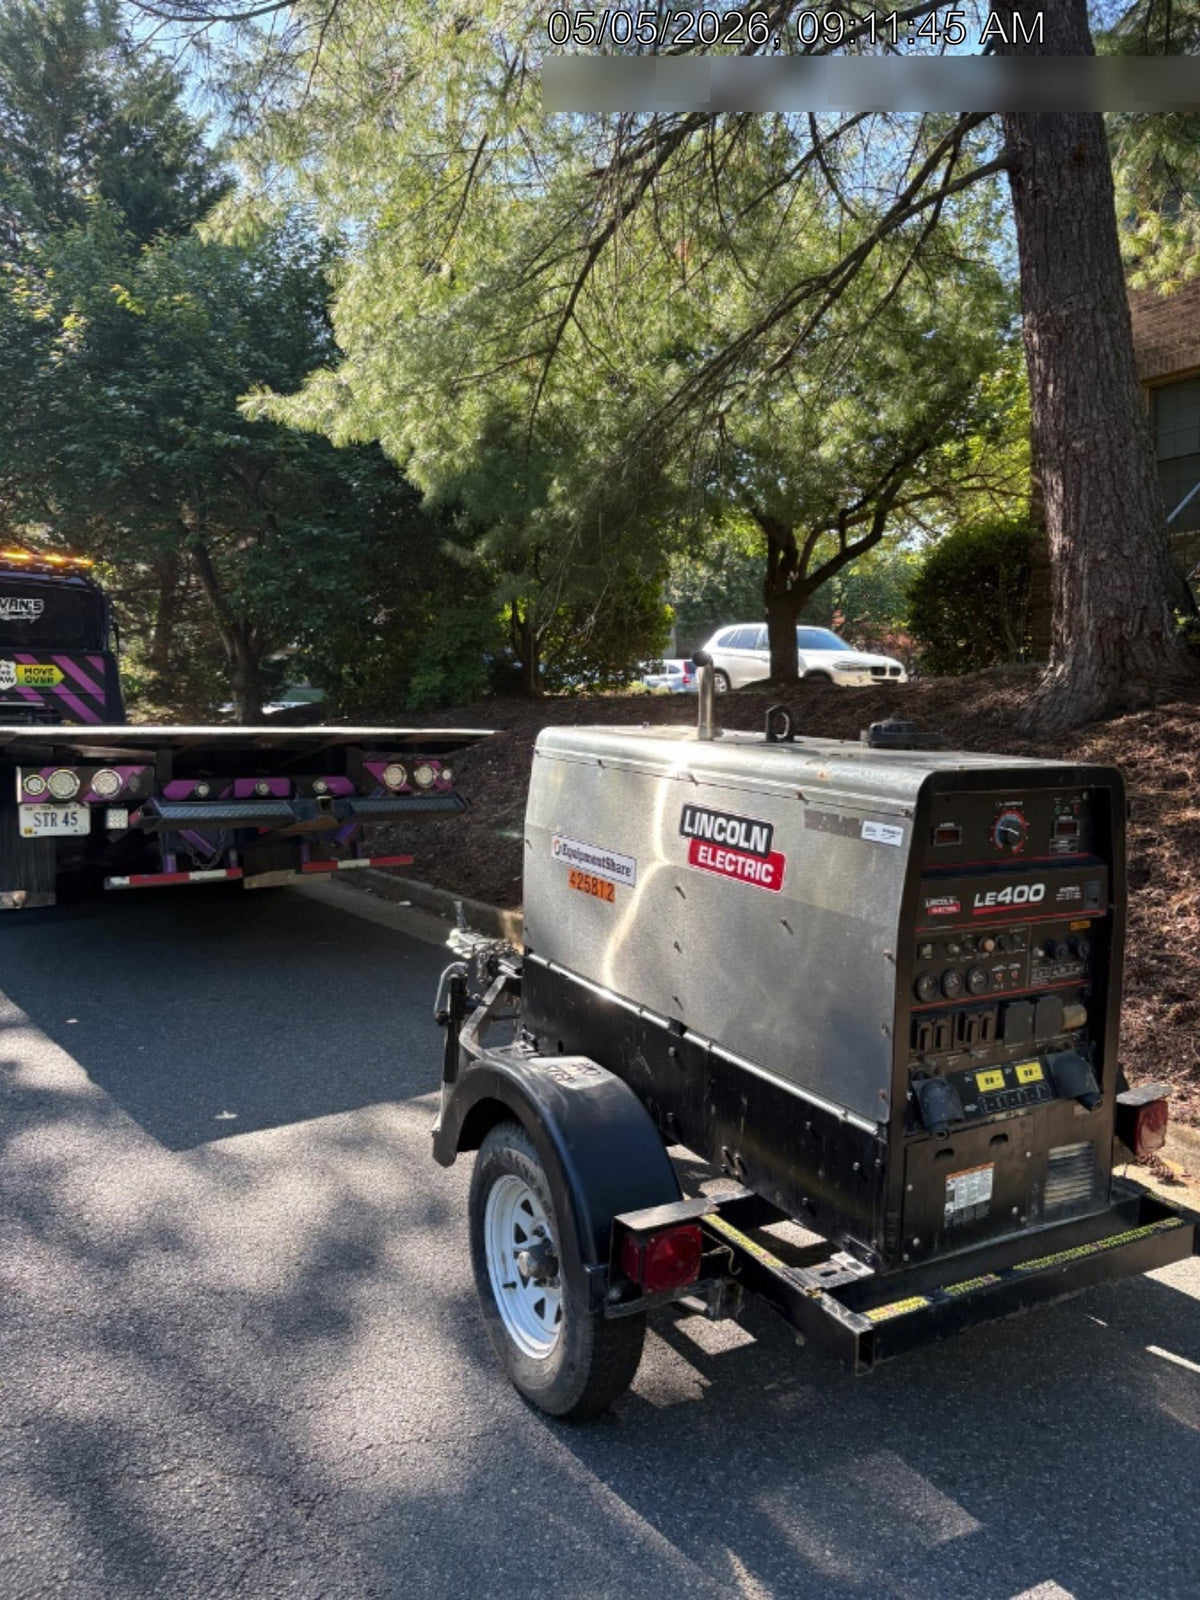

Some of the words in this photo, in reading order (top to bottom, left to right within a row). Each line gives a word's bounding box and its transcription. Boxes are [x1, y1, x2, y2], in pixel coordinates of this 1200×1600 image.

[33, 811, 57, 828] STR
[62, 811, 79, 827] 45
[683, 809, 769, 854] LINCOLN
[562, 842, 632, 878] EquipmentShare
[697, 844, 775, 884] ELECTRIC
[973, 882, 1046, 908] LE400
